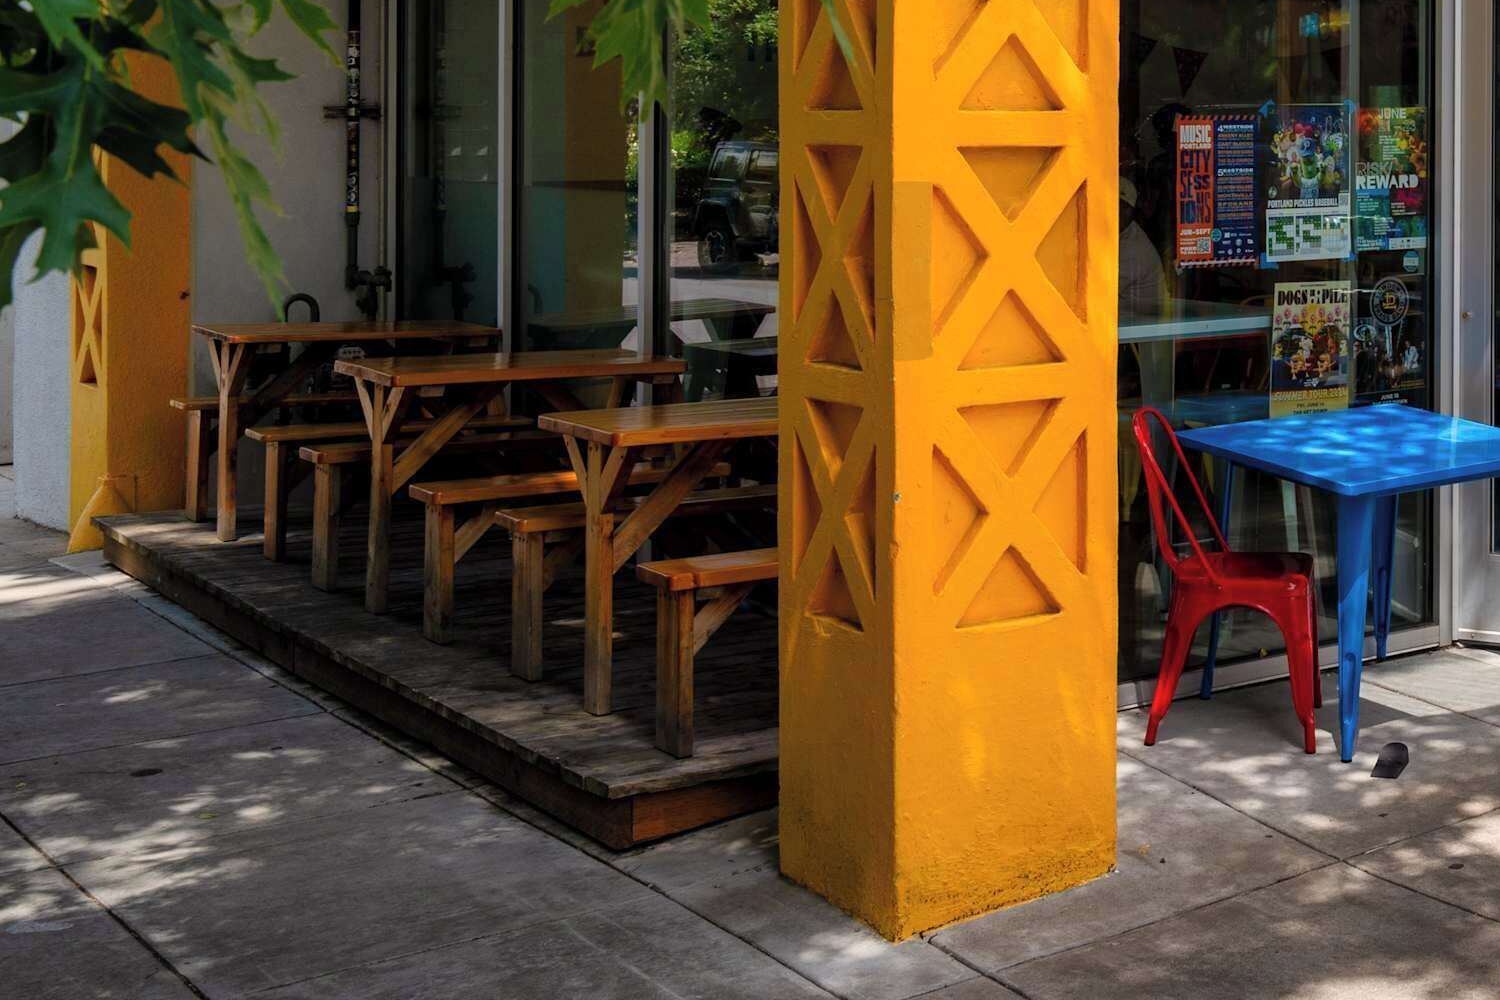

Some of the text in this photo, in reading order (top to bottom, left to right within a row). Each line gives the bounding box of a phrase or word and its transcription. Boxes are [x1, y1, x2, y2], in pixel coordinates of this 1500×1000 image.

[1180, 125, 1211, 142] MUSIC
[1180, 150, 1211, 172] CITY
[1356, 174, 1419, 190] REWARD
[1268, 197, 1338, 209] PORTLAND PICKLES BASEBALL
[1278, 288, 1308, 306] DOGS
